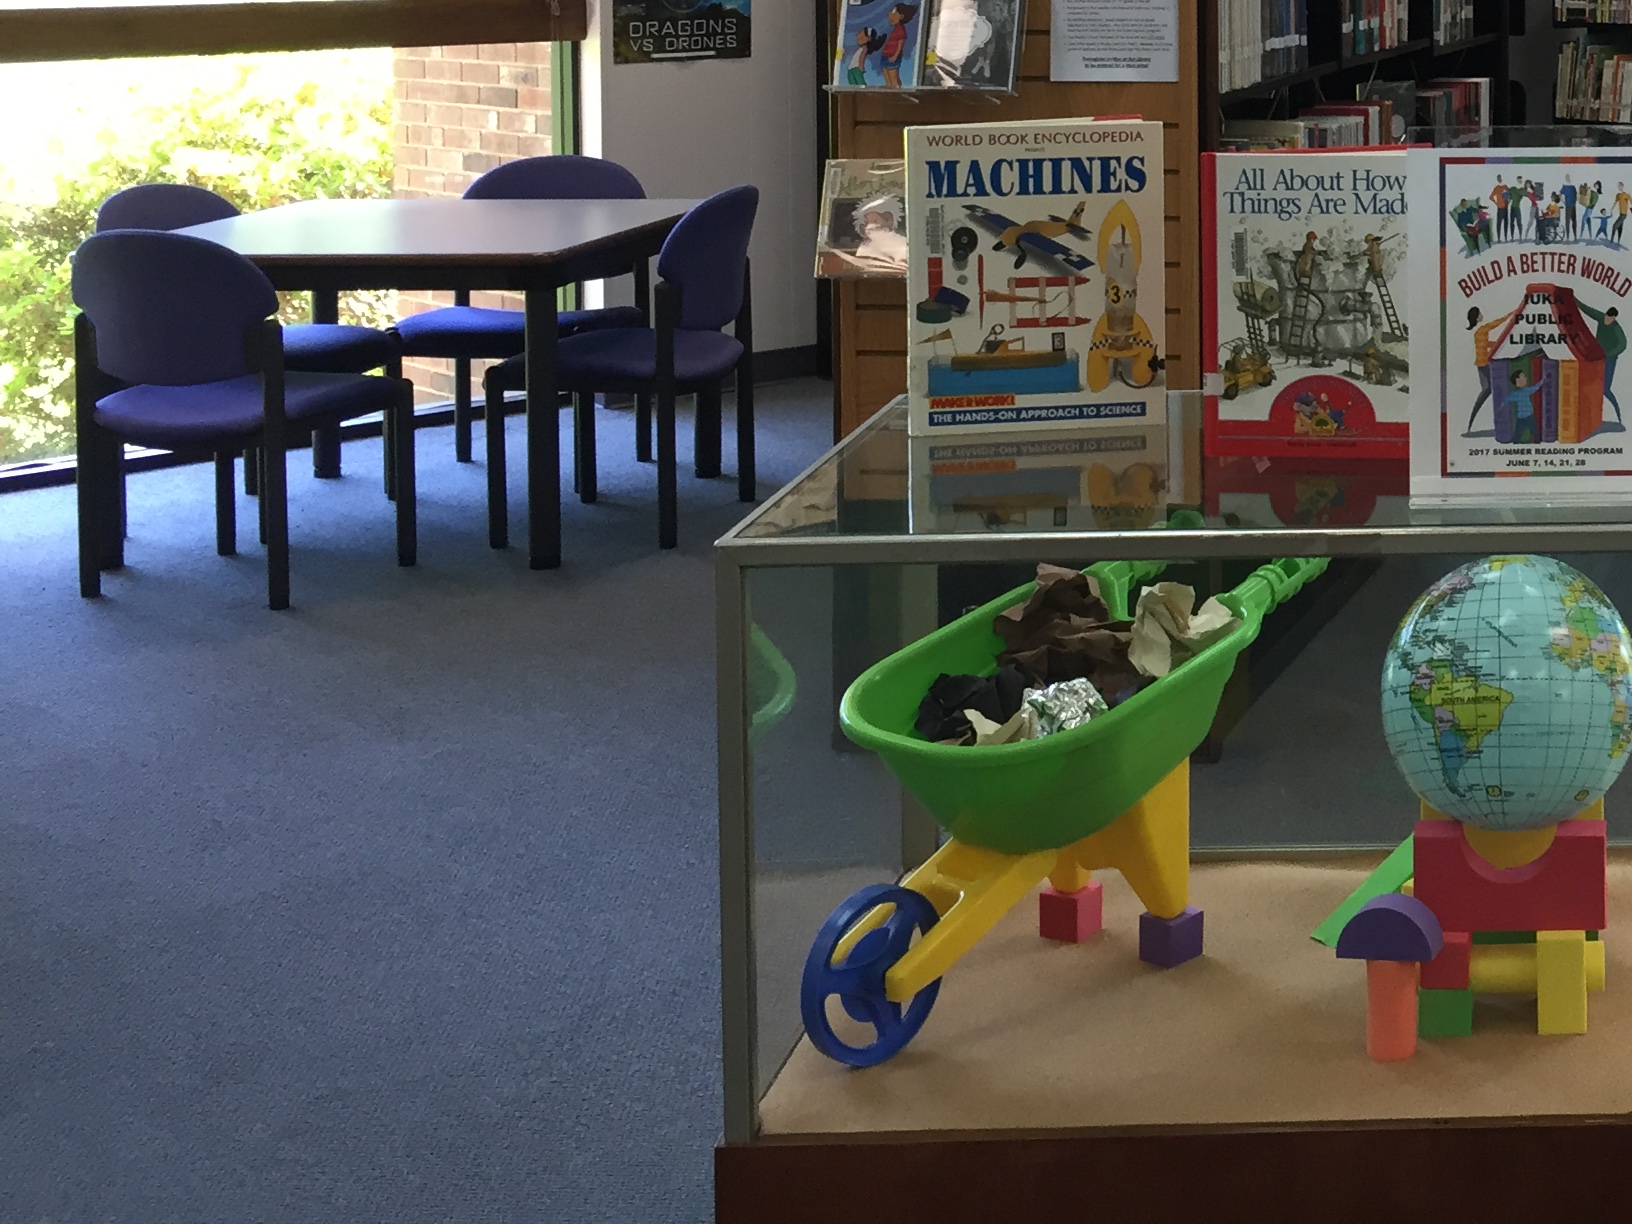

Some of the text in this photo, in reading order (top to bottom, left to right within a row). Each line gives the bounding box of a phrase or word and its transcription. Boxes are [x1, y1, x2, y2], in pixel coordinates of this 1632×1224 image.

[629, 18, 737, 37] DRAGONS
[630, 35, 737, 52] VS DRONES
[926, 130, 1145, 147] WORLD BOOK ENCYCLOPEDIA
[925, 155, 1147, 199] MACHINES
[1234, 168, 1407, 192] All About How
[1223, 191, 1408, 222] Things Are Mad
[1457, 251, 1632, 298] BUILD A BETTER WORLD
[1110, 284, 1122, 305] 3
[1525, 294, 1565, 306] IUKA
[1515, 313, 1574, 325] PUBLIC
[1509, 333, 1580, 346] LIBRARY
[933, 404, 1142, 423] THE HANDS-ON APPROACH TO SCIENCE
[1469, 447, 1623, 456] 2017 SUMMER READING PROGRAM
[1506, 459, 1530, 467] JUNE
